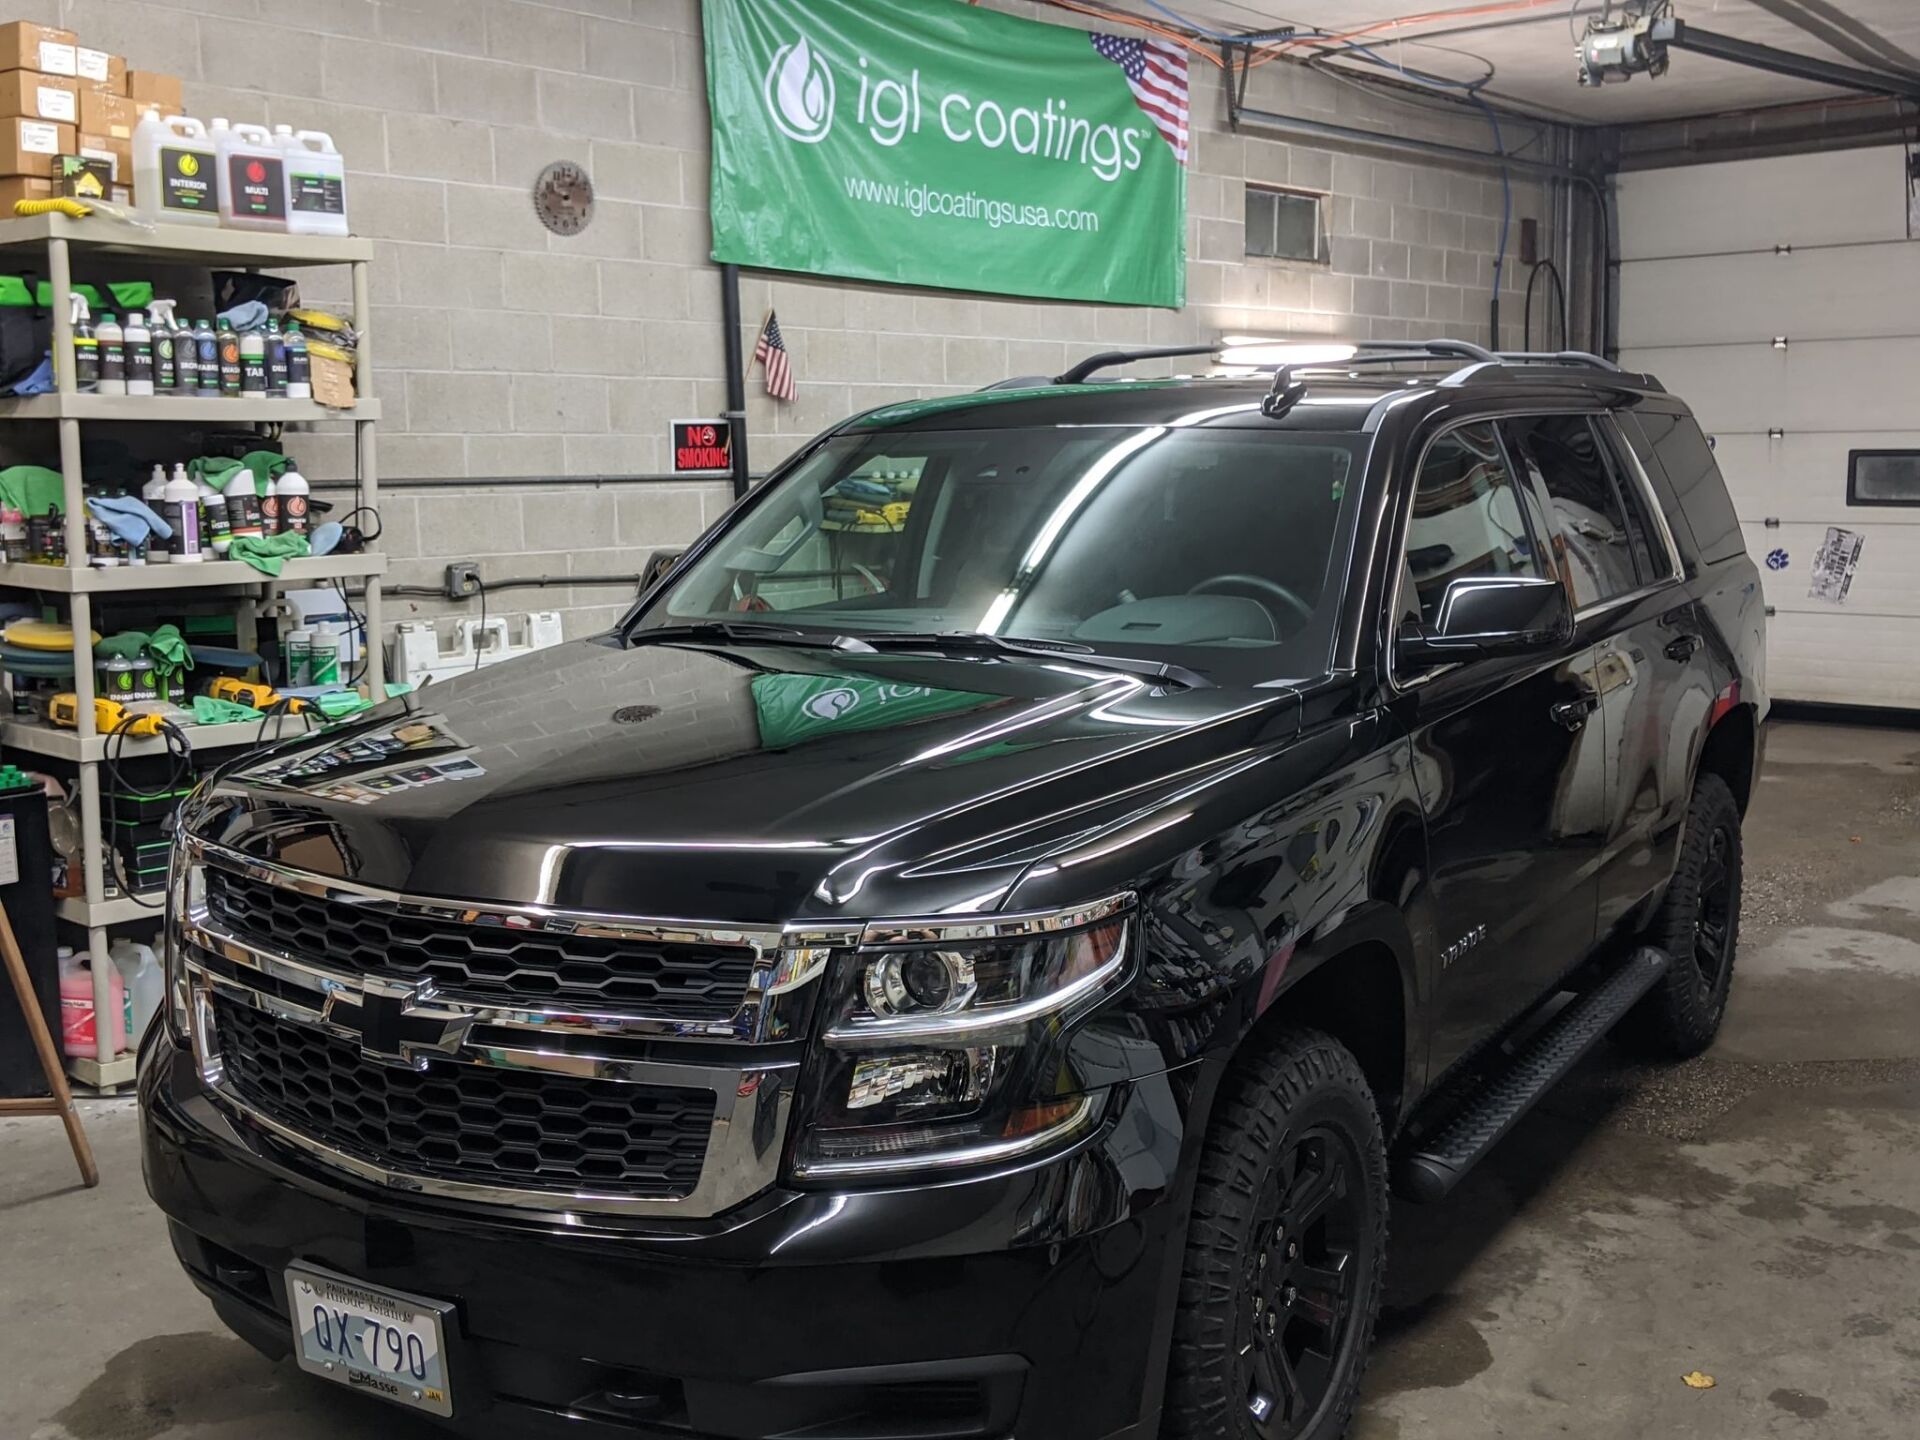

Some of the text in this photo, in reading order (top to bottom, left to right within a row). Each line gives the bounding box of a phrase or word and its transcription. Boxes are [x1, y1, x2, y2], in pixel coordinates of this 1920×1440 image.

[857, 56, 920, 147] igl
[939, 97, 1142, 182] coatings
[170, 177, 208, 191] INTERIOR
[844, 176, 1099, 233] www.iglcoatingsusa.com
[687, 425, 716, 447] NO
[677, 447, 728, 469] SMOKING
[326, 1282, 397, 1309] PAULMASSE.COM
[313, 1305, 427, 1380] QX-790
[360, 1371, 399, 1396] Masse
